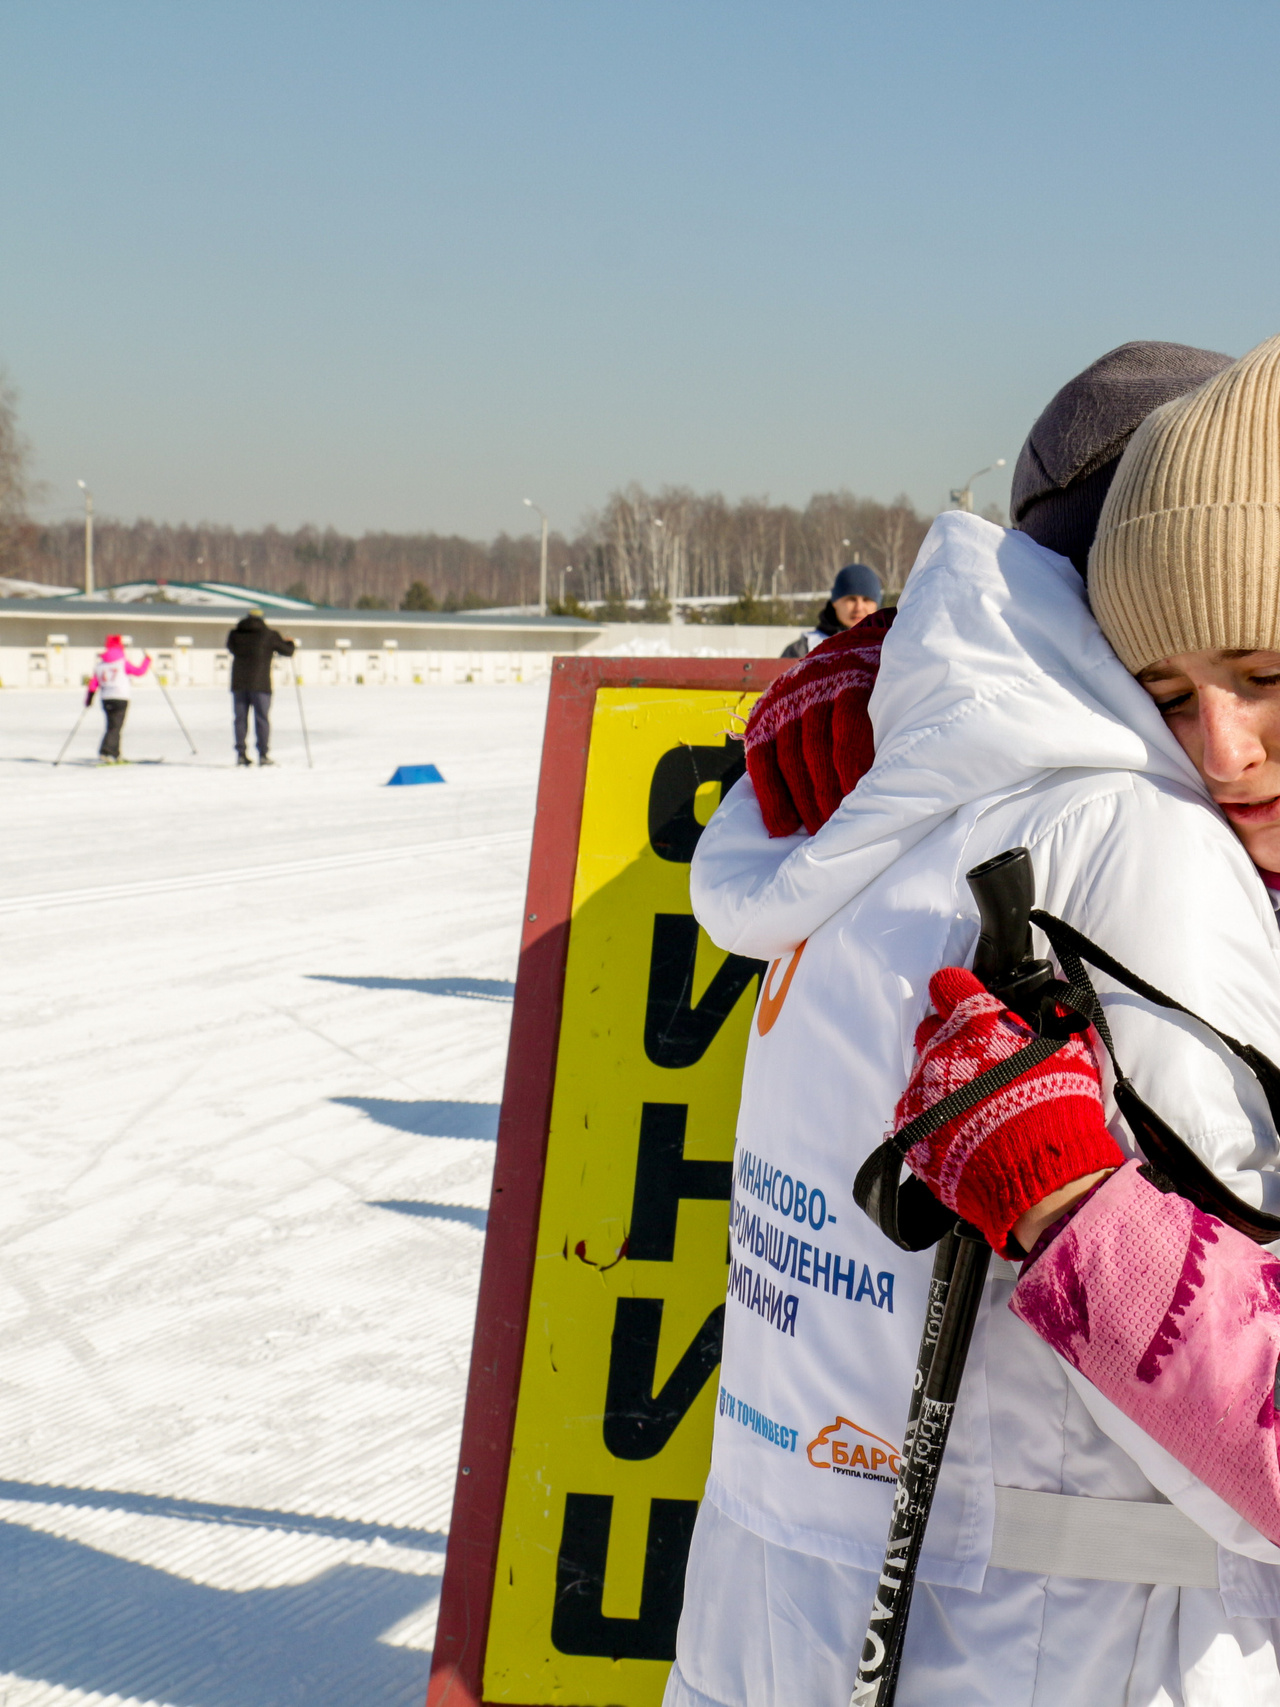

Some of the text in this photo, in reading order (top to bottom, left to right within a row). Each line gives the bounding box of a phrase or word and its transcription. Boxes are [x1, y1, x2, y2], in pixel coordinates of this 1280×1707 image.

[738, 1147, 837, 1231] ИНАНСОВО-
[727, 1254, 799, 1337] МПАНИЯ
[733, 1199, 895, 1314] РОМЫШЛЕННАЯ
[737, 1399, 799, 1453] ТОЧИНВЕСТ
[832, 1466, 898, 1485] ГРУППА КОМПАН
